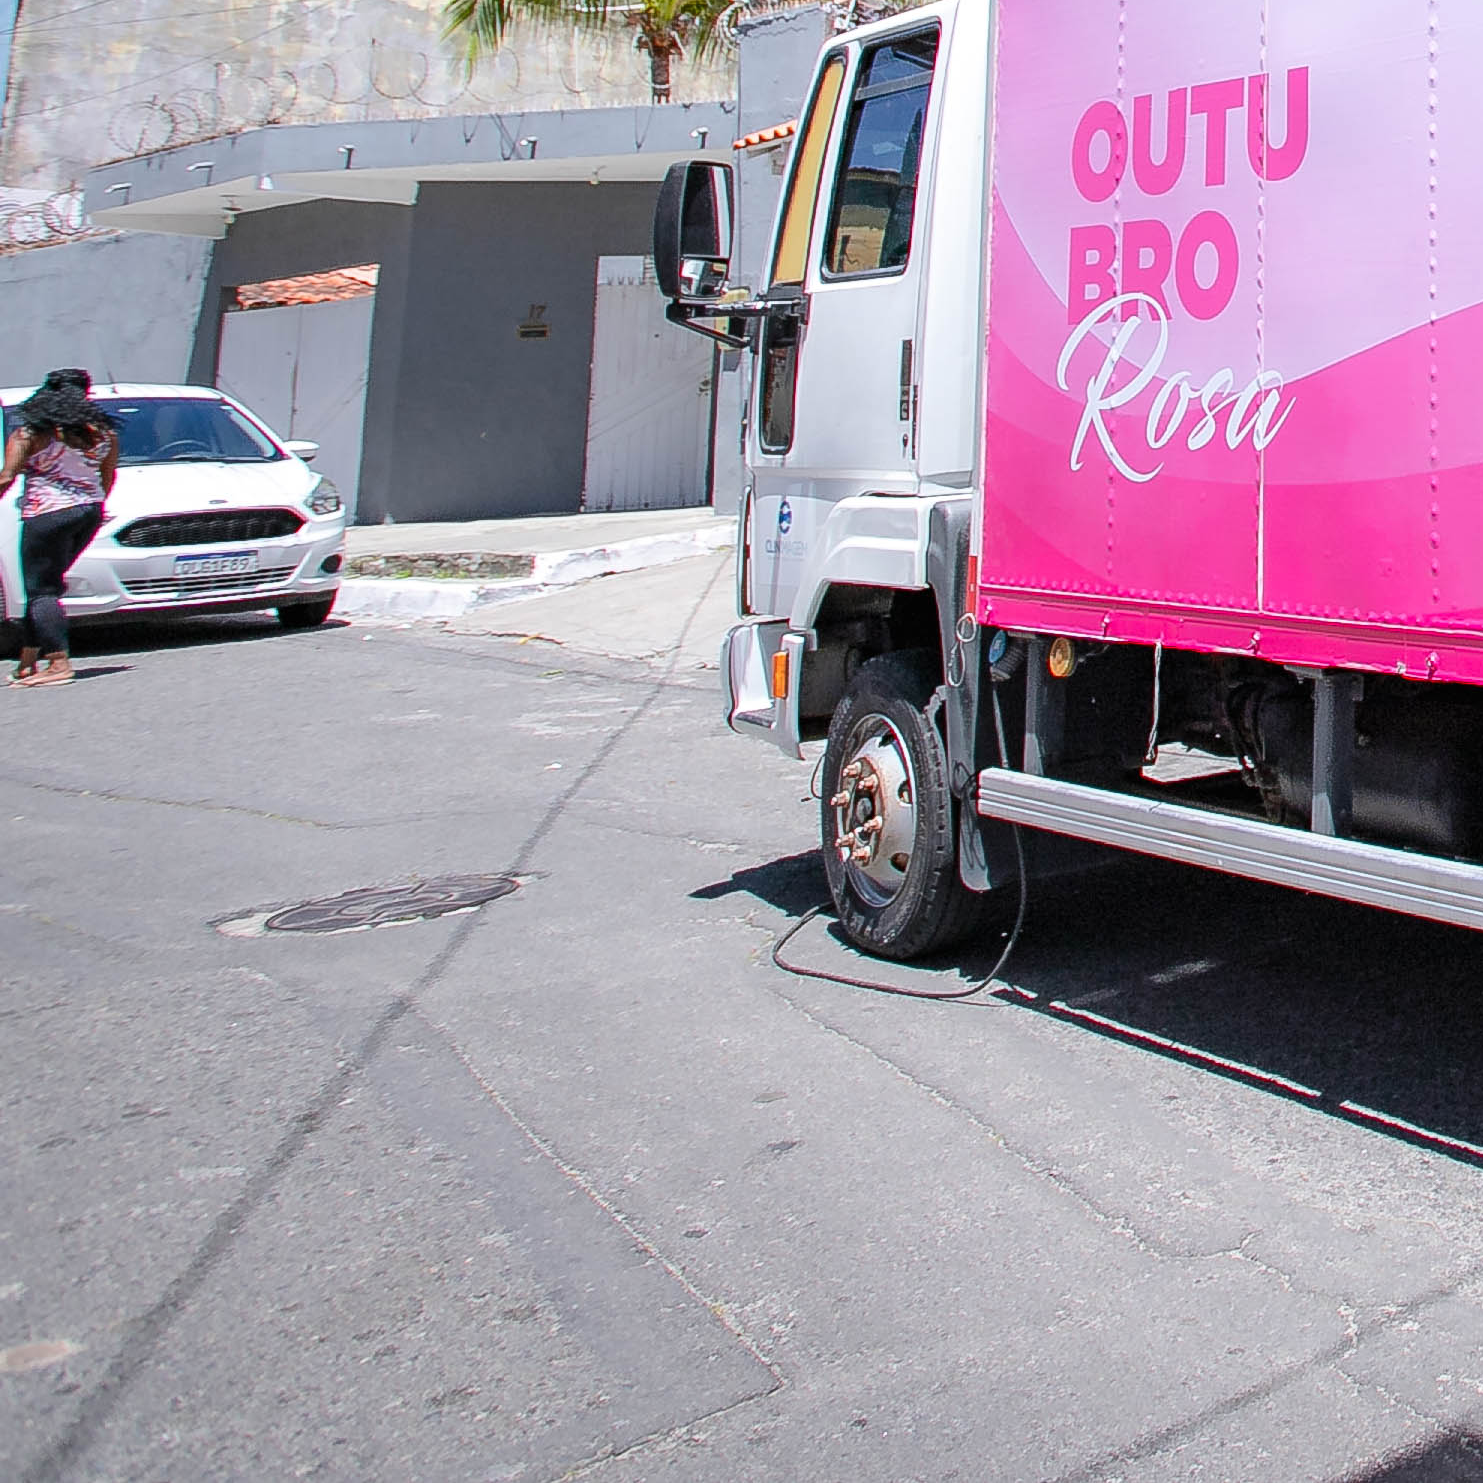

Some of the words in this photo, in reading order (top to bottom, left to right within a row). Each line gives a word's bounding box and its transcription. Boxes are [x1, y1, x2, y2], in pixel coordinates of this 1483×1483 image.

[1070, 65, 1310, 203] OUTU
[1067, 209, 1240, 326] BRO
[1056, 291, 1297, 483] Rosa
